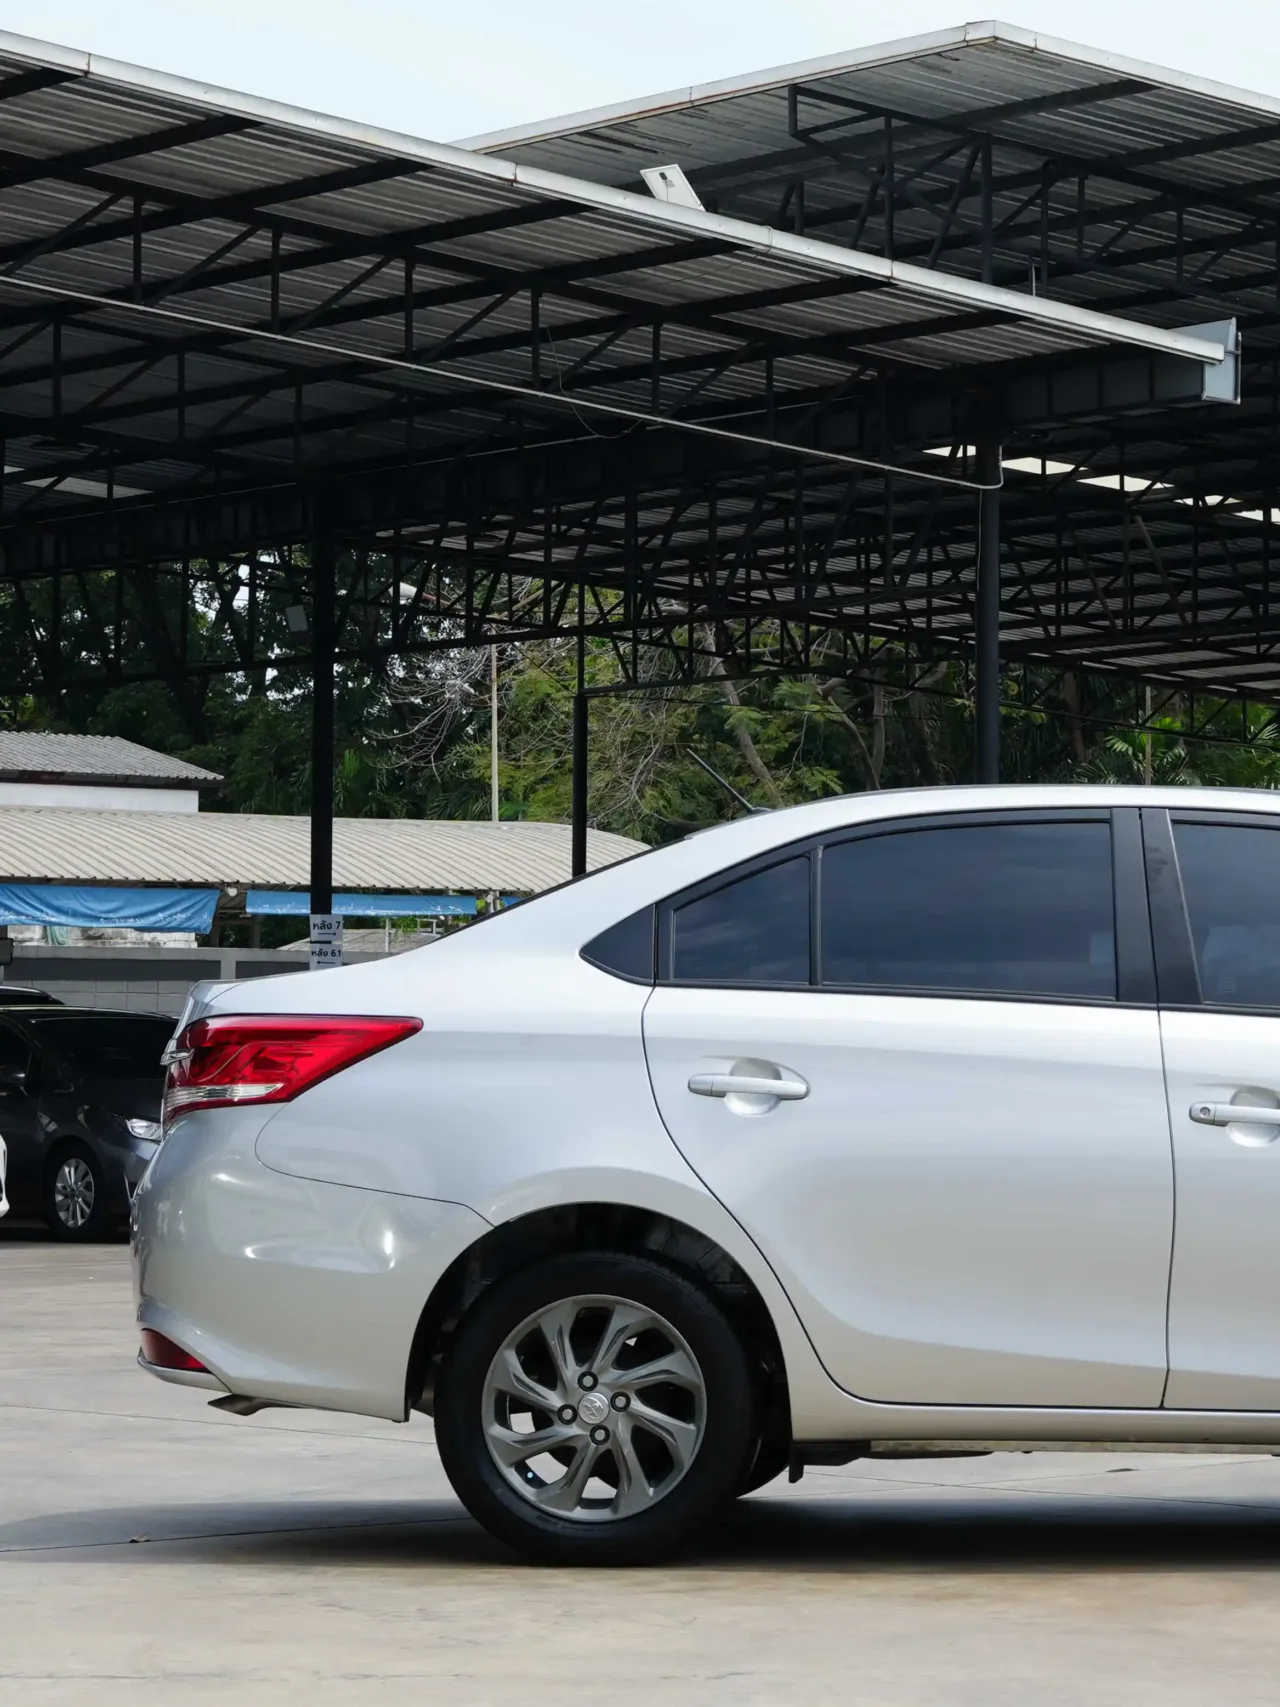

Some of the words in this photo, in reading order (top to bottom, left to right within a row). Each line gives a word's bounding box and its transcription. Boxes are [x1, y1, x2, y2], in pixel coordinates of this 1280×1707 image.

[313, 920, 332, 930] หลัง
[335, 920, 341, 930] 7
[311, 948, 328, 957] หลัง
